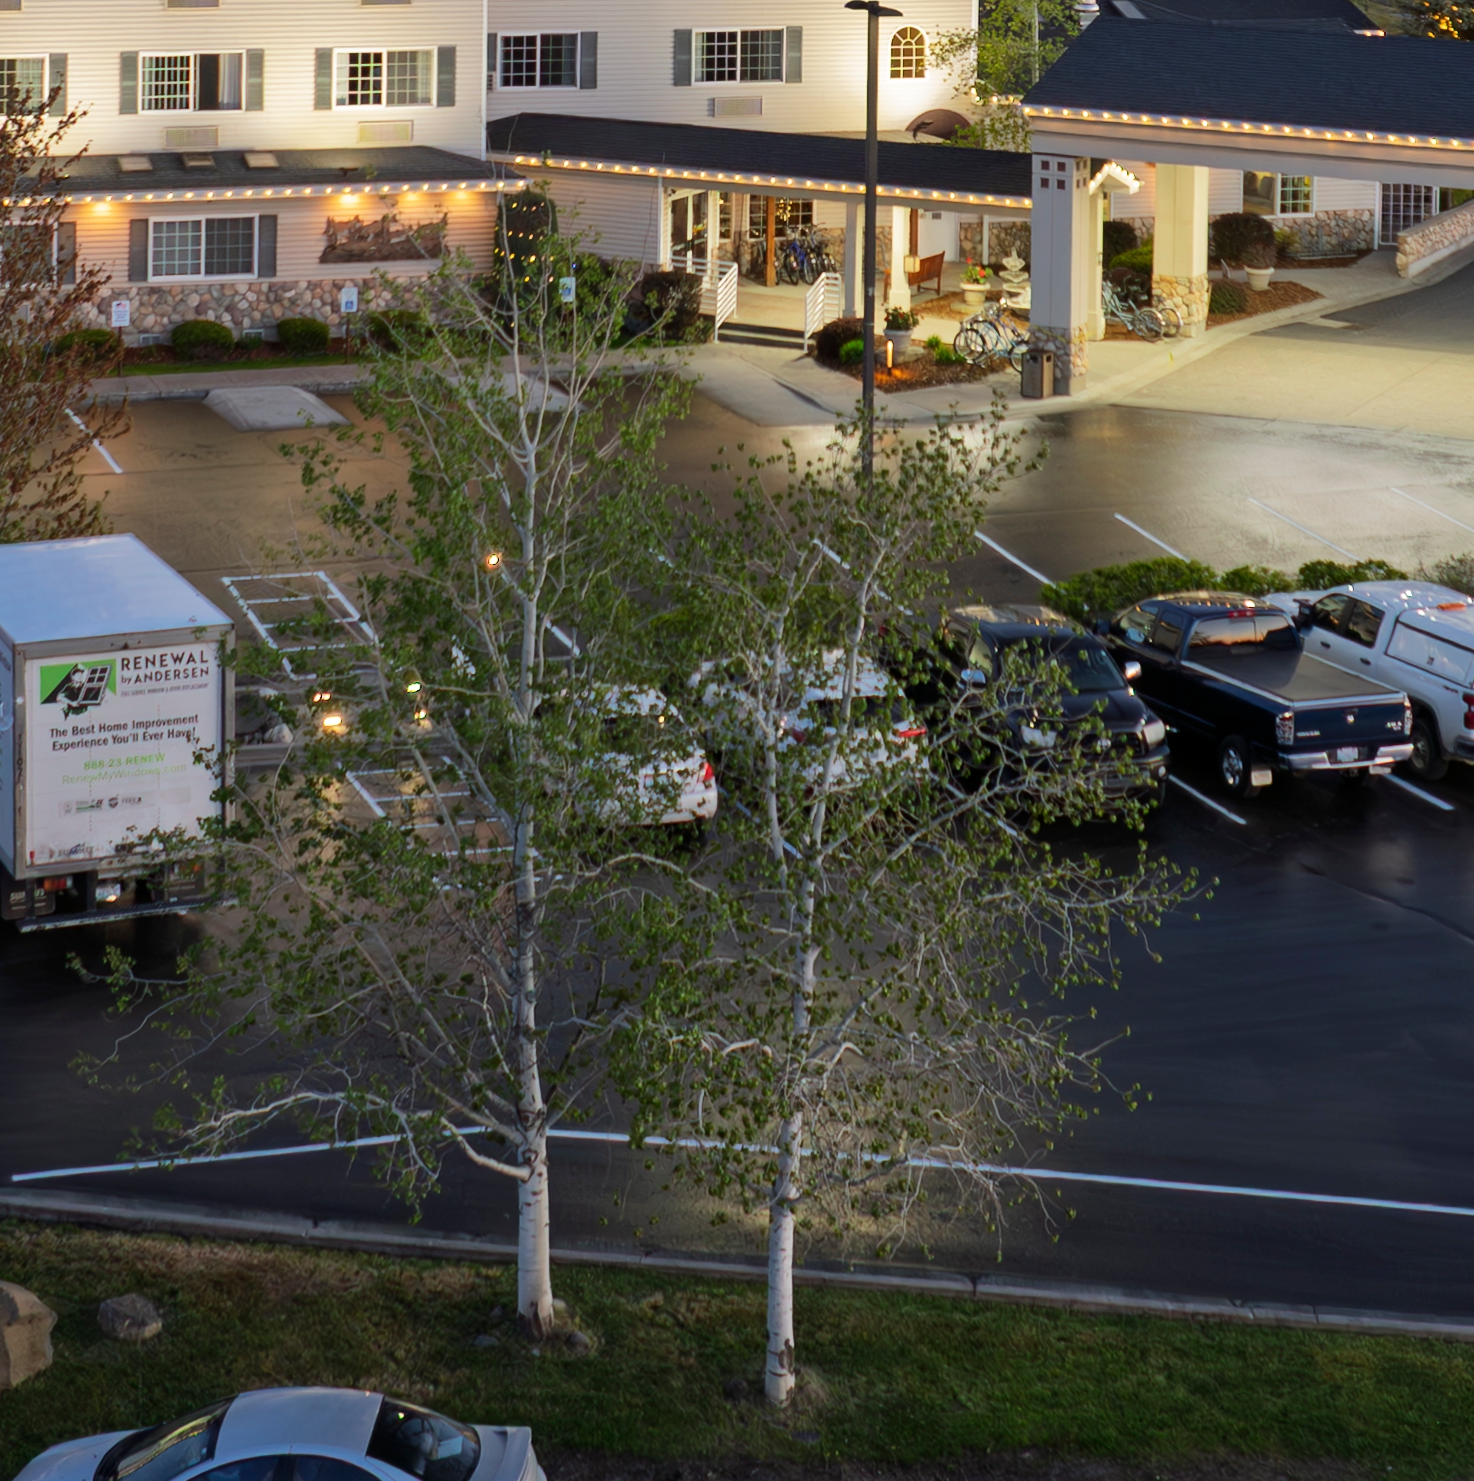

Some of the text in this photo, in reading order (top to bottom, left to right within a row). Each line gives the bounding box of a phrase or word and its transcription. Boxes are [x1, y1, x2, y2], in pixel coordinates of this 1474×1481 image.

[121, 650, 209, 671] RENEWAL
[121, 666, 209, 685] by ANDERSEN
[50, 714, 199, 739] The Best Home Improvement
[52, 726, 196, 752] Experience You'll Ever Have!
[62, 764, 187, 785] RenewMyWindows.com
